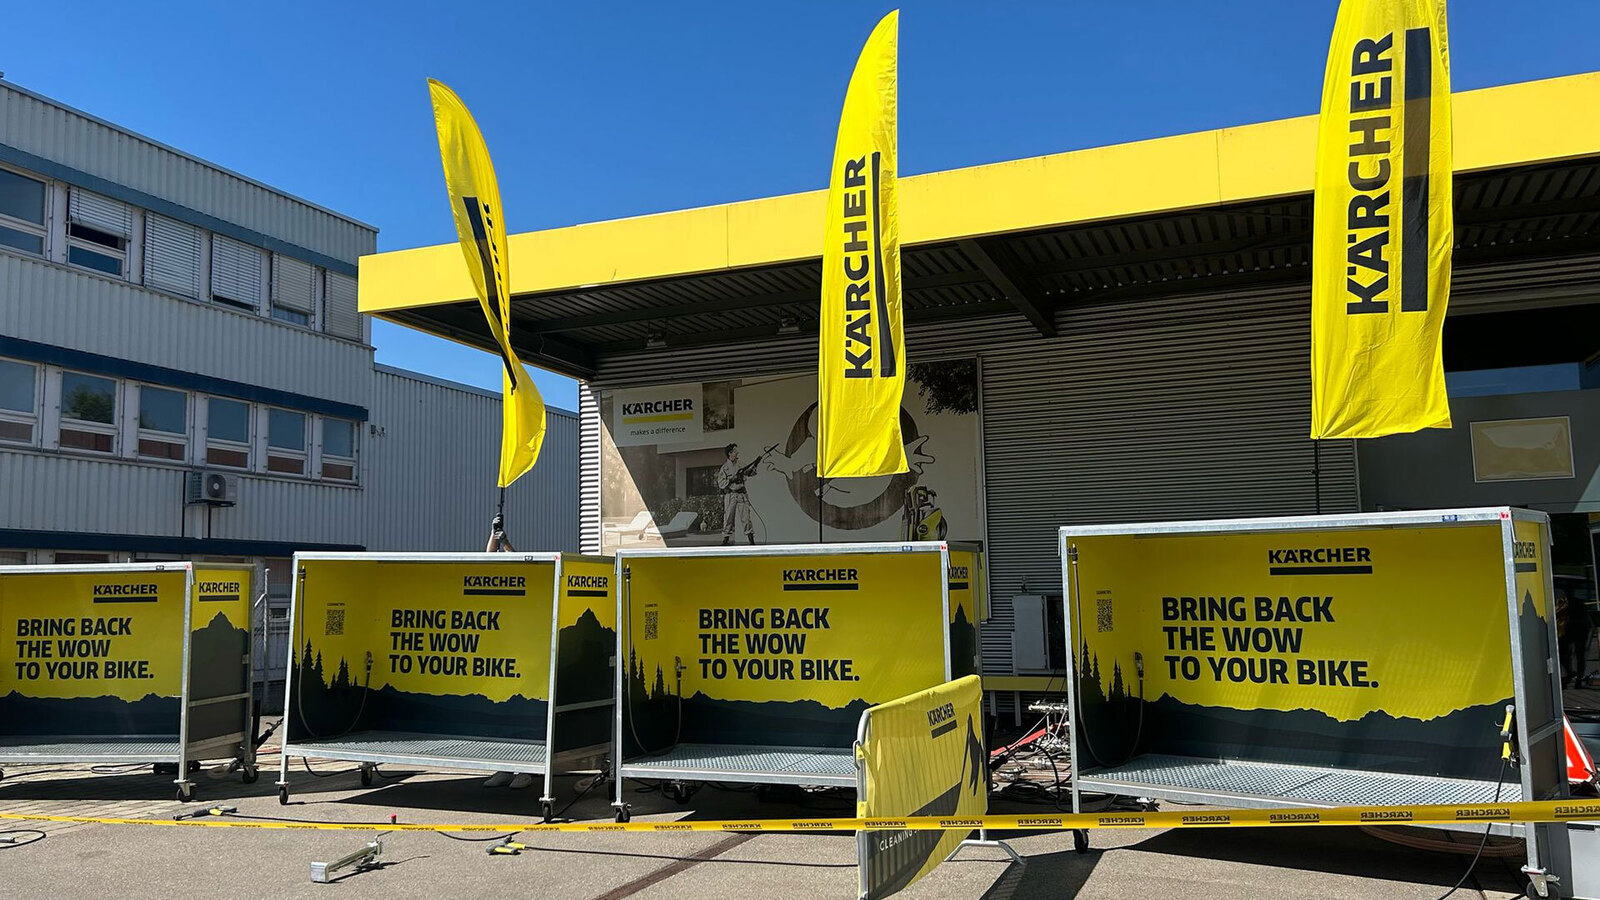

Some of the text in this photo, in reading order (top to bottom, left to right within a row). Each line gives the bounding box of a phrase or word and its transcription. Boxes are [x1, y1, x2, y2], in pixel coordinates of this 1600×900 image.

[1346, 31, 1394, 315] KÄRCHER
[843, 154, 873, 379] KÄRCHER
[622, 399, 693, 415] KÄRCHER
[656, 426, 686, 434] difference
[1268, 547, 1371, 563] KÄRCHER
[463, 575, 525, 587] KÄRCHER
[567, 575, 608, 587] KÄRCHER
[782, 568, 857, 581] KÄRCHER
[93, 584, 157, 595] KÄRCHER
[198, 581, 239, 592] KÄRCHER
[391, 609, 500, 630] BRING BACK
[698, 607, 830, 629] BRING BACK
[1161, 596, 1335, 622] BRING BACK
[16, 617, 132, 636] BRING BACK
[15, 639, 110, 658] THE WOW
[390, 631, 479, 652] THE WOW
[698, 632, 806, 654] THE WOW
[1162, 626, 1303, 653] THE WOW
[14, 660, 154, 680] TO YOUR BIKE.
[388, 654, 520, 678] TO YOUR BIKE.
[698, 658, 859, 681] TO YOUR BIKE.
[1163, 655, 1379, 688] TO YOUR BIKE.
[926, 702, 956, 726] KÄRCHER
